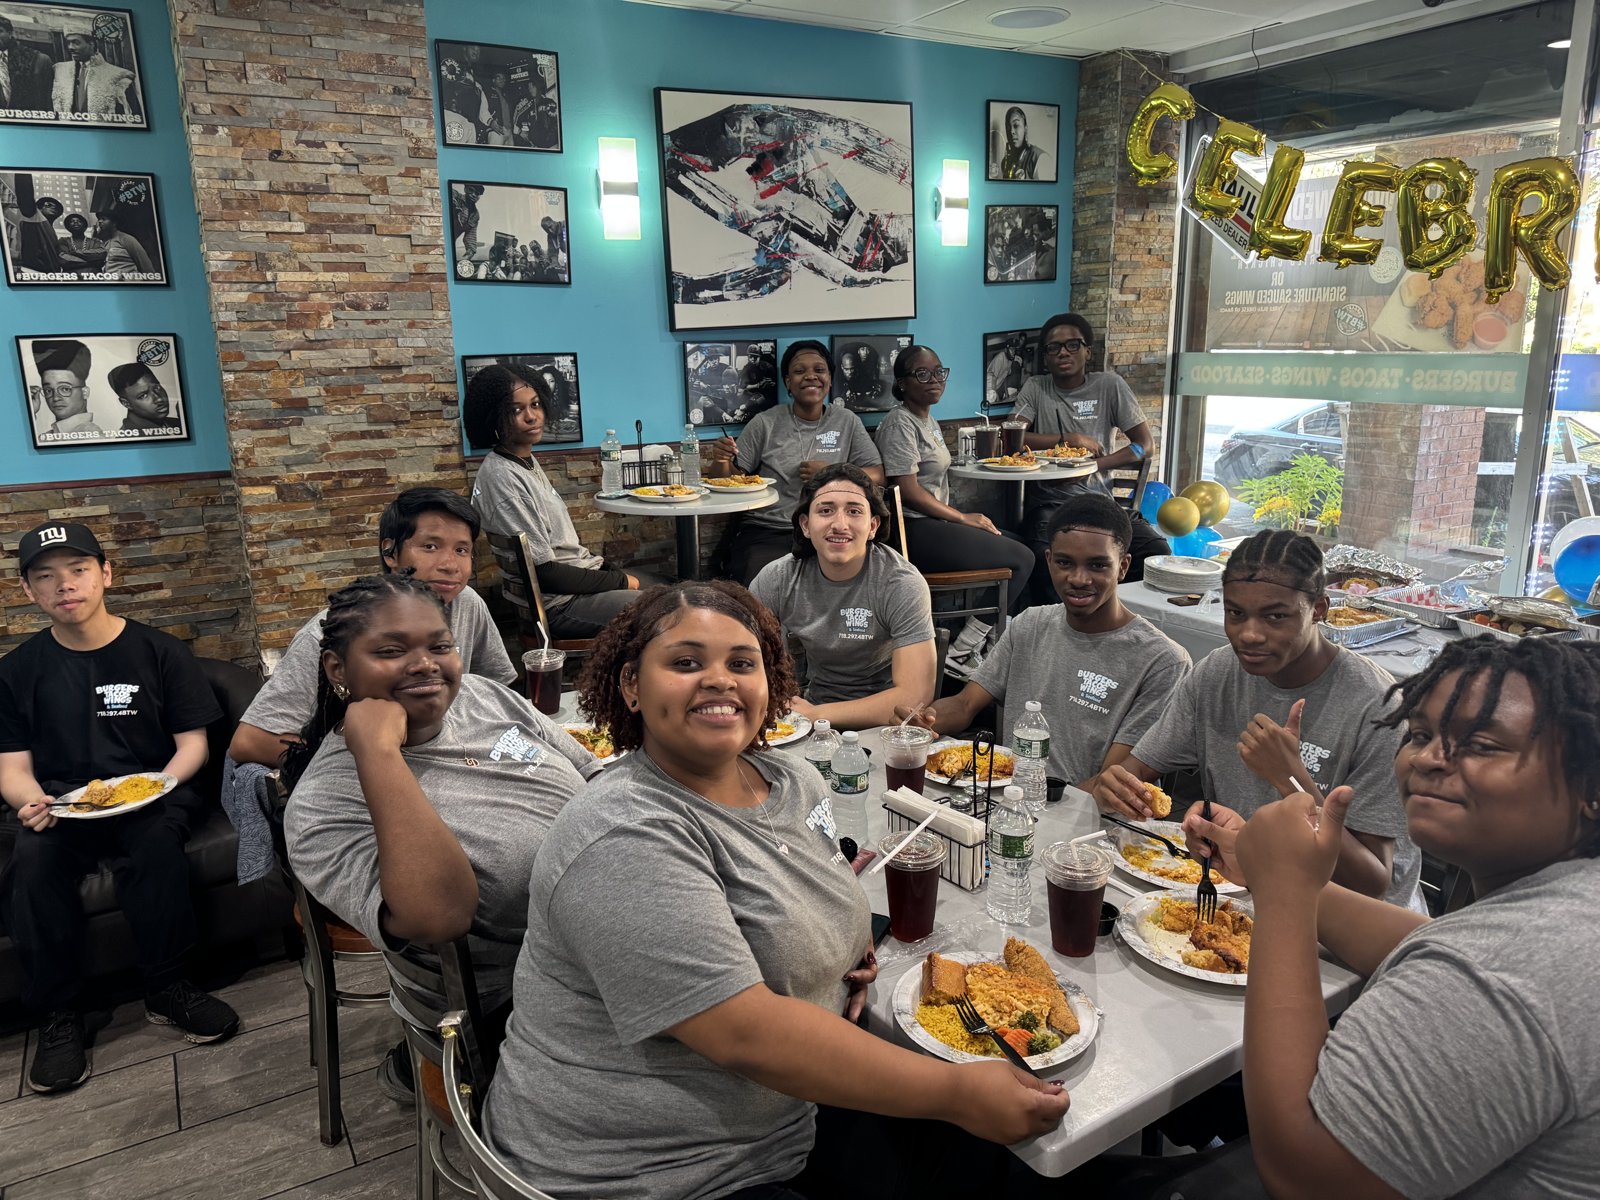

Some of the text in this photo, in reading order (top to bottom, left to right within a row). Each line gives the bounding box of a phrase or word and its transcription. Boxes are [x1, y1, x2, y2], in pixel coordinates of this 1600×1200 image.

[58, 111, 98, 121] TACOS
[100, 113, 142, 123] WINGS
[119, 182, 147, 203] #BTW
[1126, 82, 1600, 303] CELEBR
[1223, 227, 1249, 250] DEALER
[81, 272, 119, 281] TACOS
[122, 272, 162, 281] WINGS
[103, 428, 140, 438] TACOS
[142, 426, 181, 436] WINGS
[840, 607, 873, 617] BURGERS
[845, 619, 869, 628] WINGS
[1077, 669, 1119, 690] BURGERS
[1083, 676, 1108, 692] TACOS
[95, 683, 140, 695] BURGERS
[104, 690, 131, 698] TACOS
[1080, 683, 1109, 699] WINGS
[103, 696, 133, 705] WINGS
[489, 725, 520, 762] BURGERS
[804, 797, 832, 832] BURG
